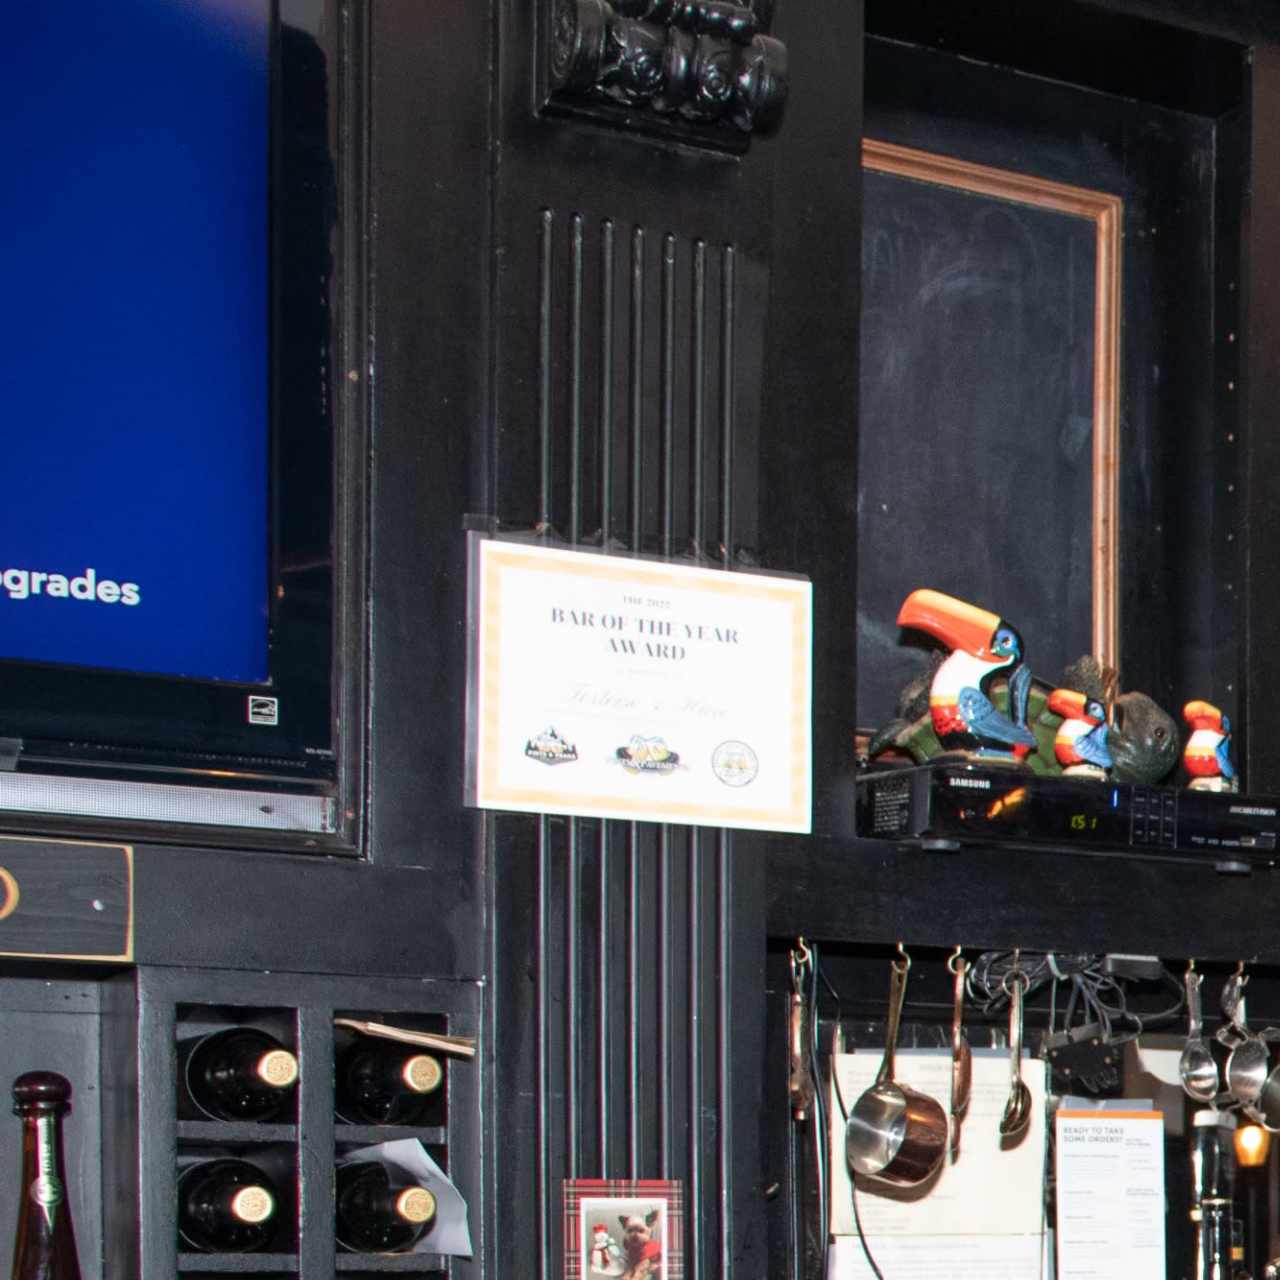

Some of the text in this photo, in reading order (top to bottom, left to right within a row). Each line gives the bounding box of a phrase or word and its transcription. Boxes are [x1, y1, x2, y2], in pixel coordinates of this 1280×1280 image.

[551, 606, 739, 644] BAR OF THE YEAR
[605, 637, 686, 661] AWARD
[949, 777, 991, 790] SAMSUNG
[1063, 1126, 1089, 1135] READY
[1091, 1126, 1103, 1135] TO
[1063, 1135, 1086, 1143] SOME
